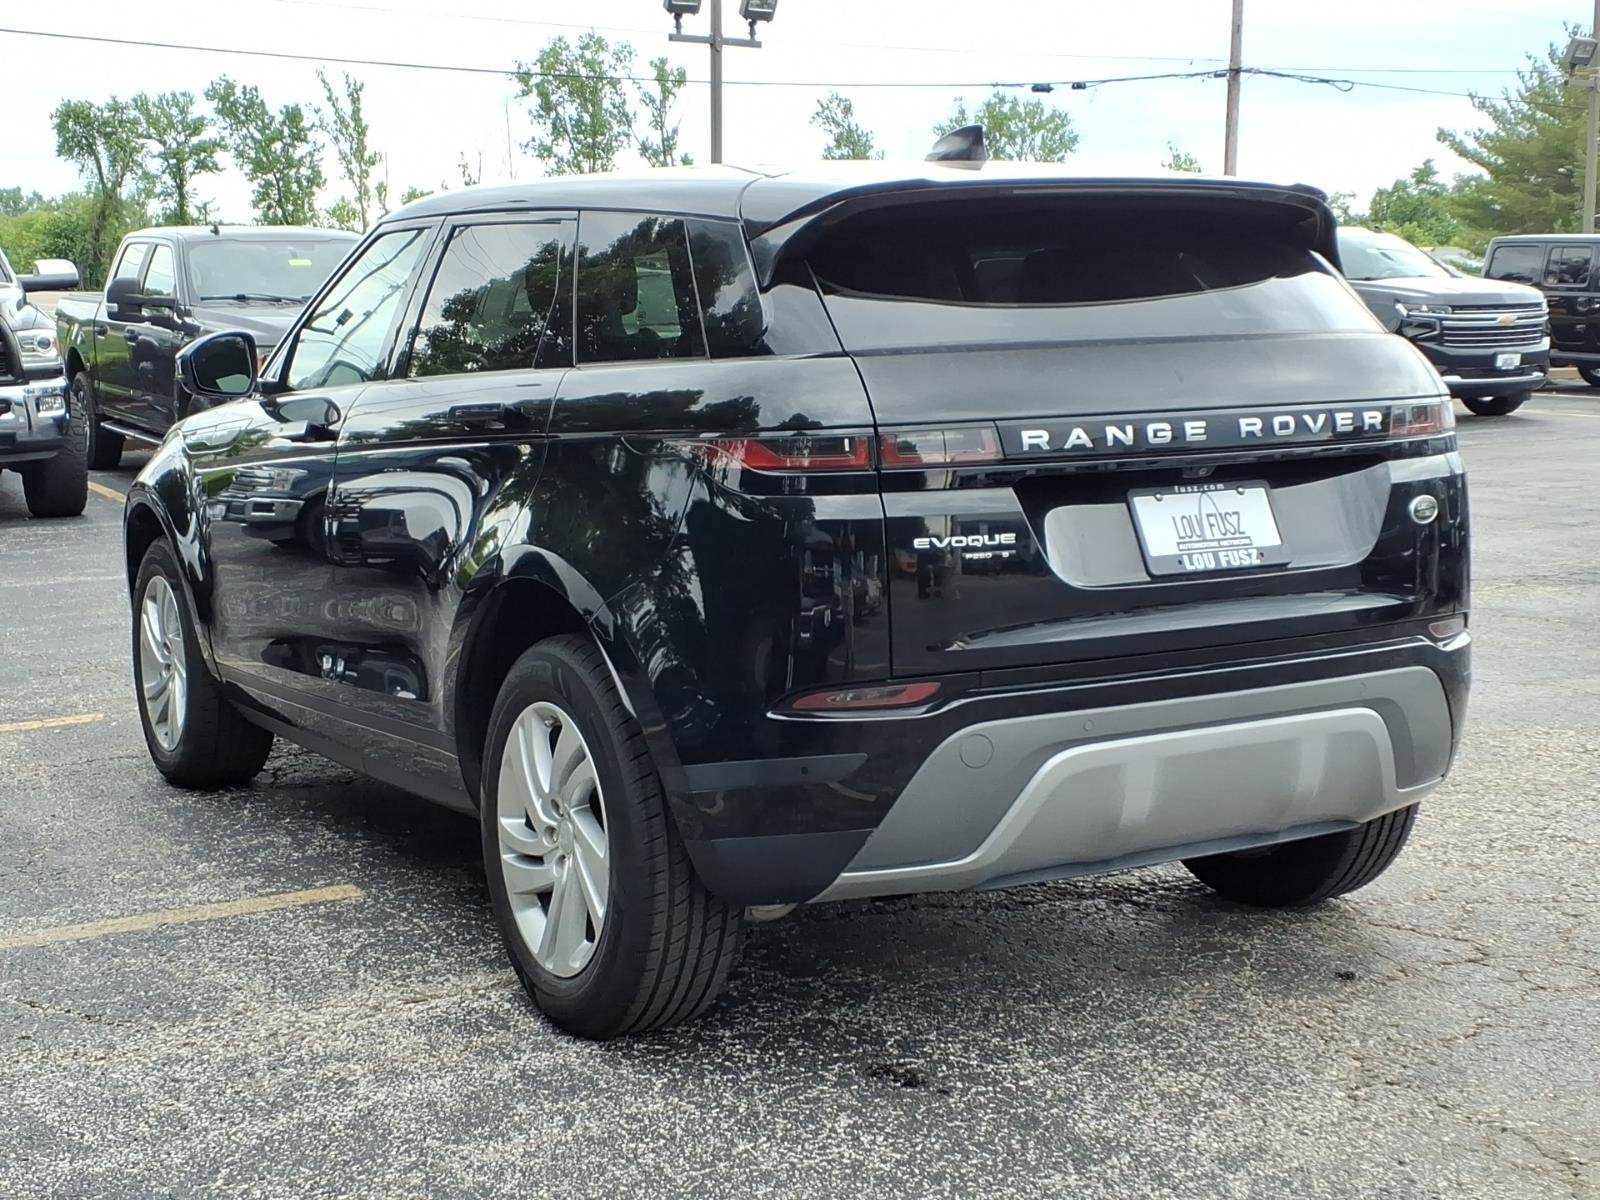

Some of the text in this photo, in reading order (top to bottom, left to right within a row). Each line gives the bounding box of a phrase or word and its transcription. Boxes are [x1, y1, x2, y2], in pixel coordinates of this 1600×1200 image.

[1021, 411, 1383, 451] RANGE ROVER
[1172, 511, 1246, 540] LOU FUSZ
[913, 533, 1016, 549] EVOQUE
[1182, 549, 1261, 570] LOU FUSZ
